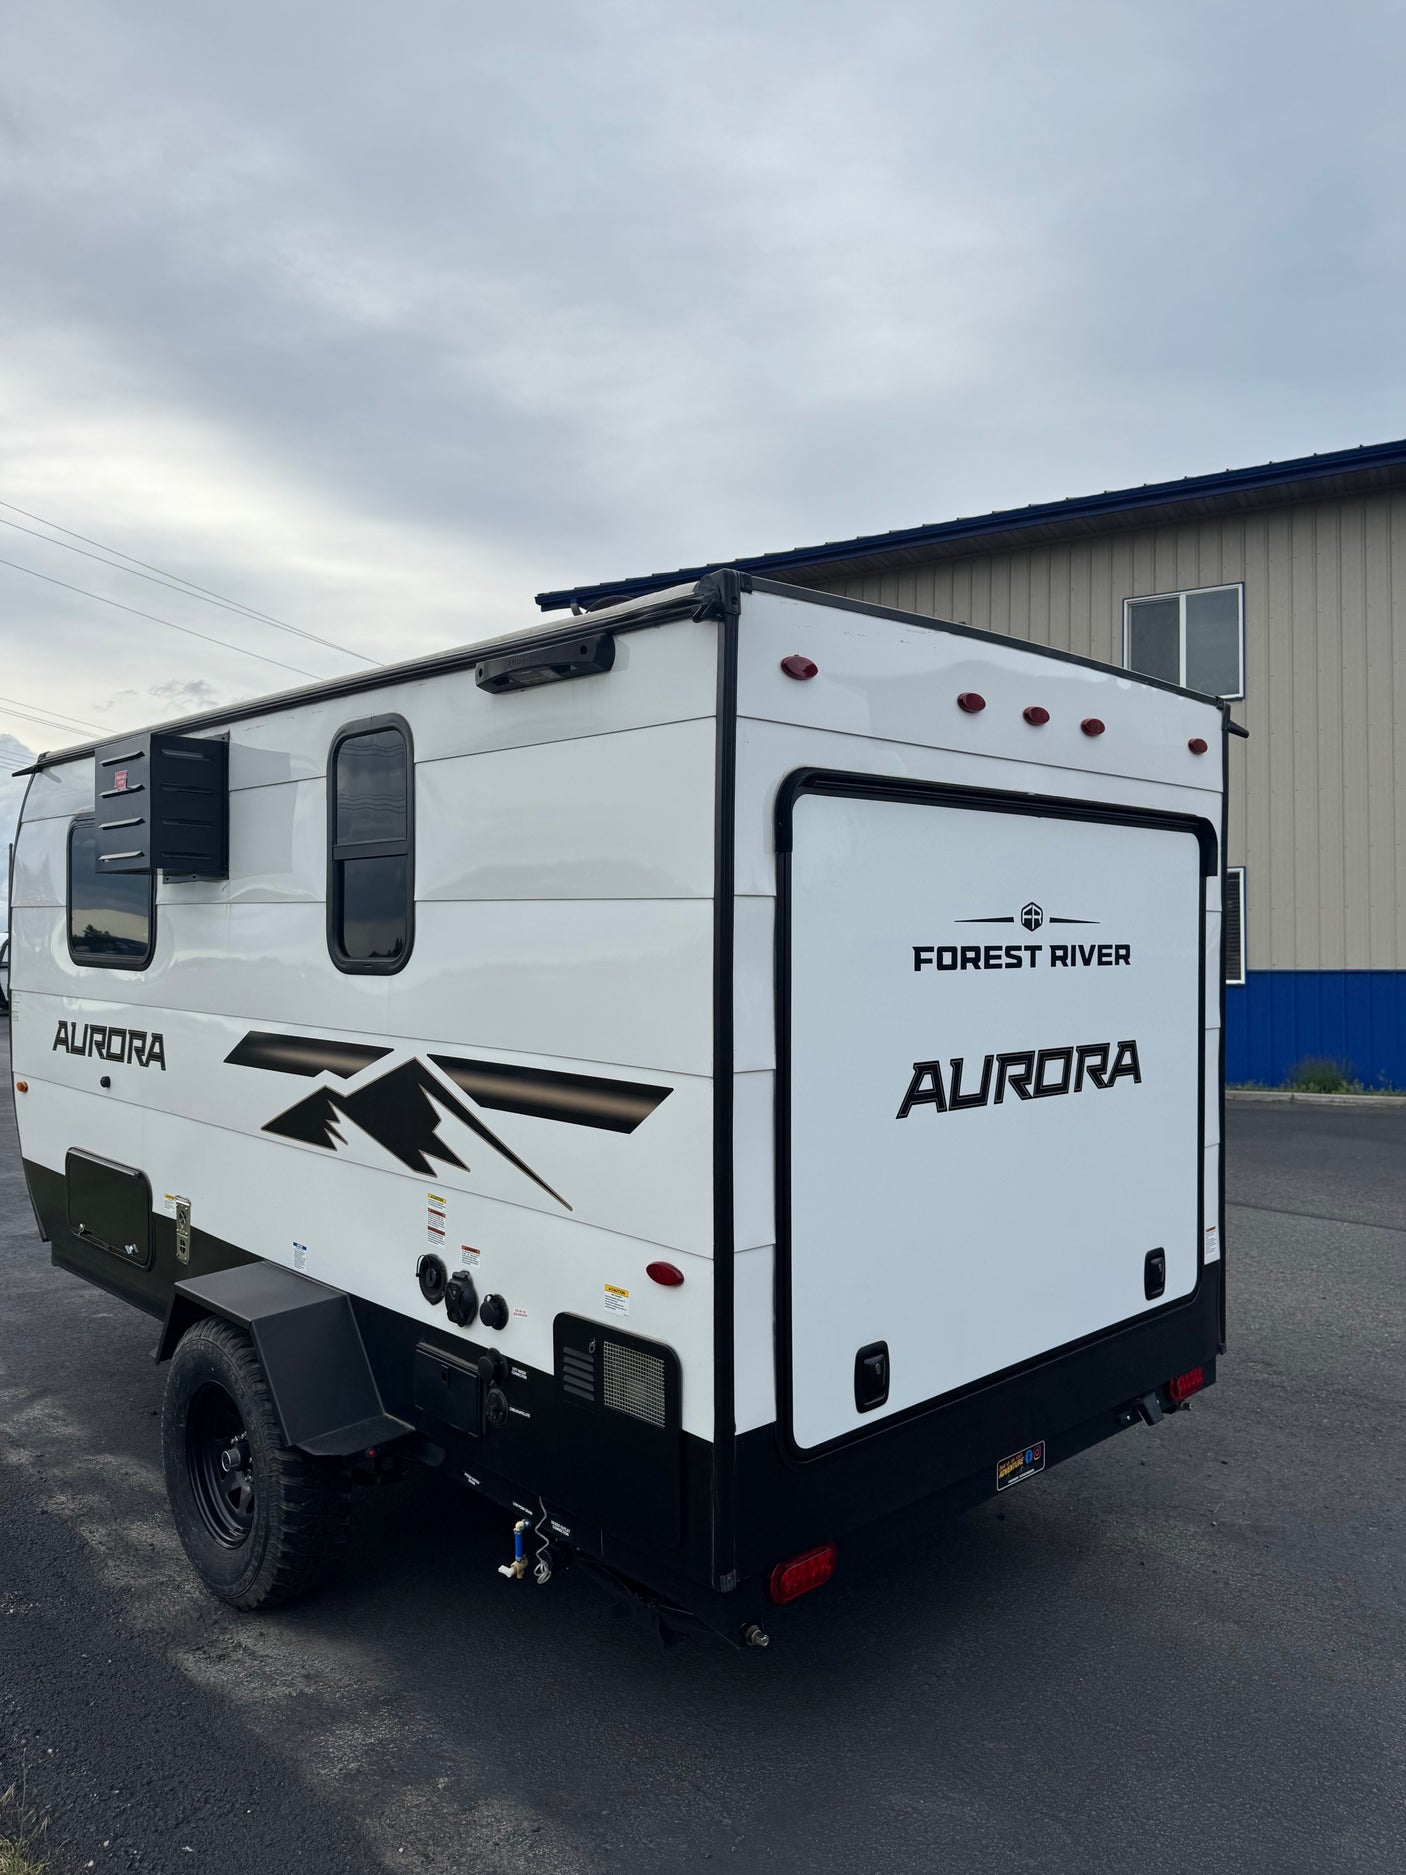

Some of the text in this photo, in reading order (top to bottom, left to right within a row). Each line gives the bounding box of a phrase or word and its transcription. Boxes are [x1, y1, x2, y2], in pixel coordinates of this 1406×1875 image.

[912, 944, 1131, 971] FOREST RIVER
[52, 1020, 166, 1071] AURORA
[895, 1040, 1142, 1119] AURORA
